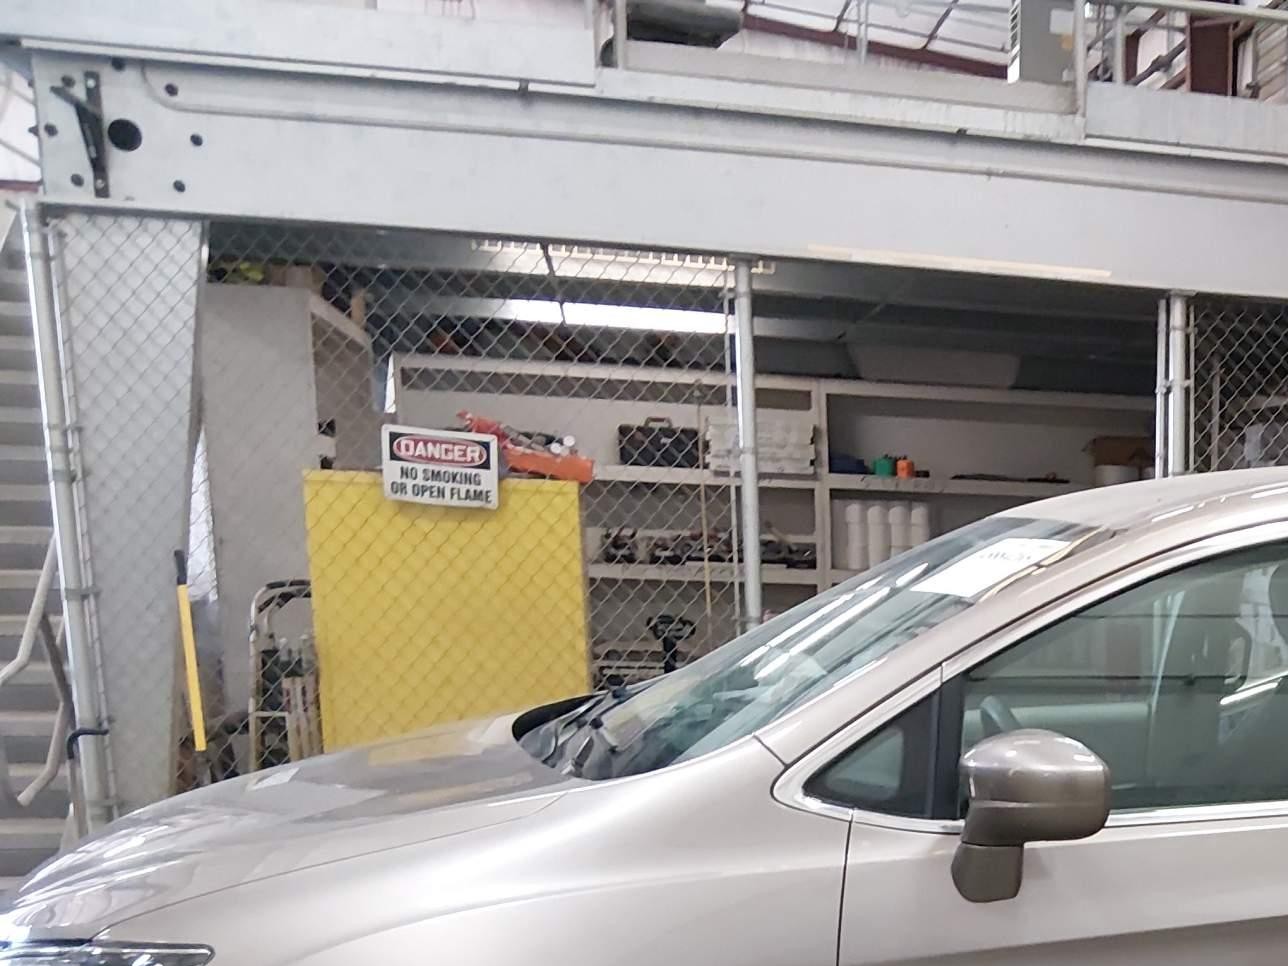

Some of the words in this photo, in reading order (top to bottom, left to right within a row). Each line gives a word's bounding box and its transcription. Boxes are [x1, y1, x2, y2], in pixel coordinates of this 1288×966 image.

[400, 439, 482, 462] DANGER
[400, 466, 418, 480] NO
[422, 469, 482, 486] SMOKING
[391, 482, 408, 495] OR
[412, 484, 445, 499] OPEN
[450, 487, 493, 504] FLAME
